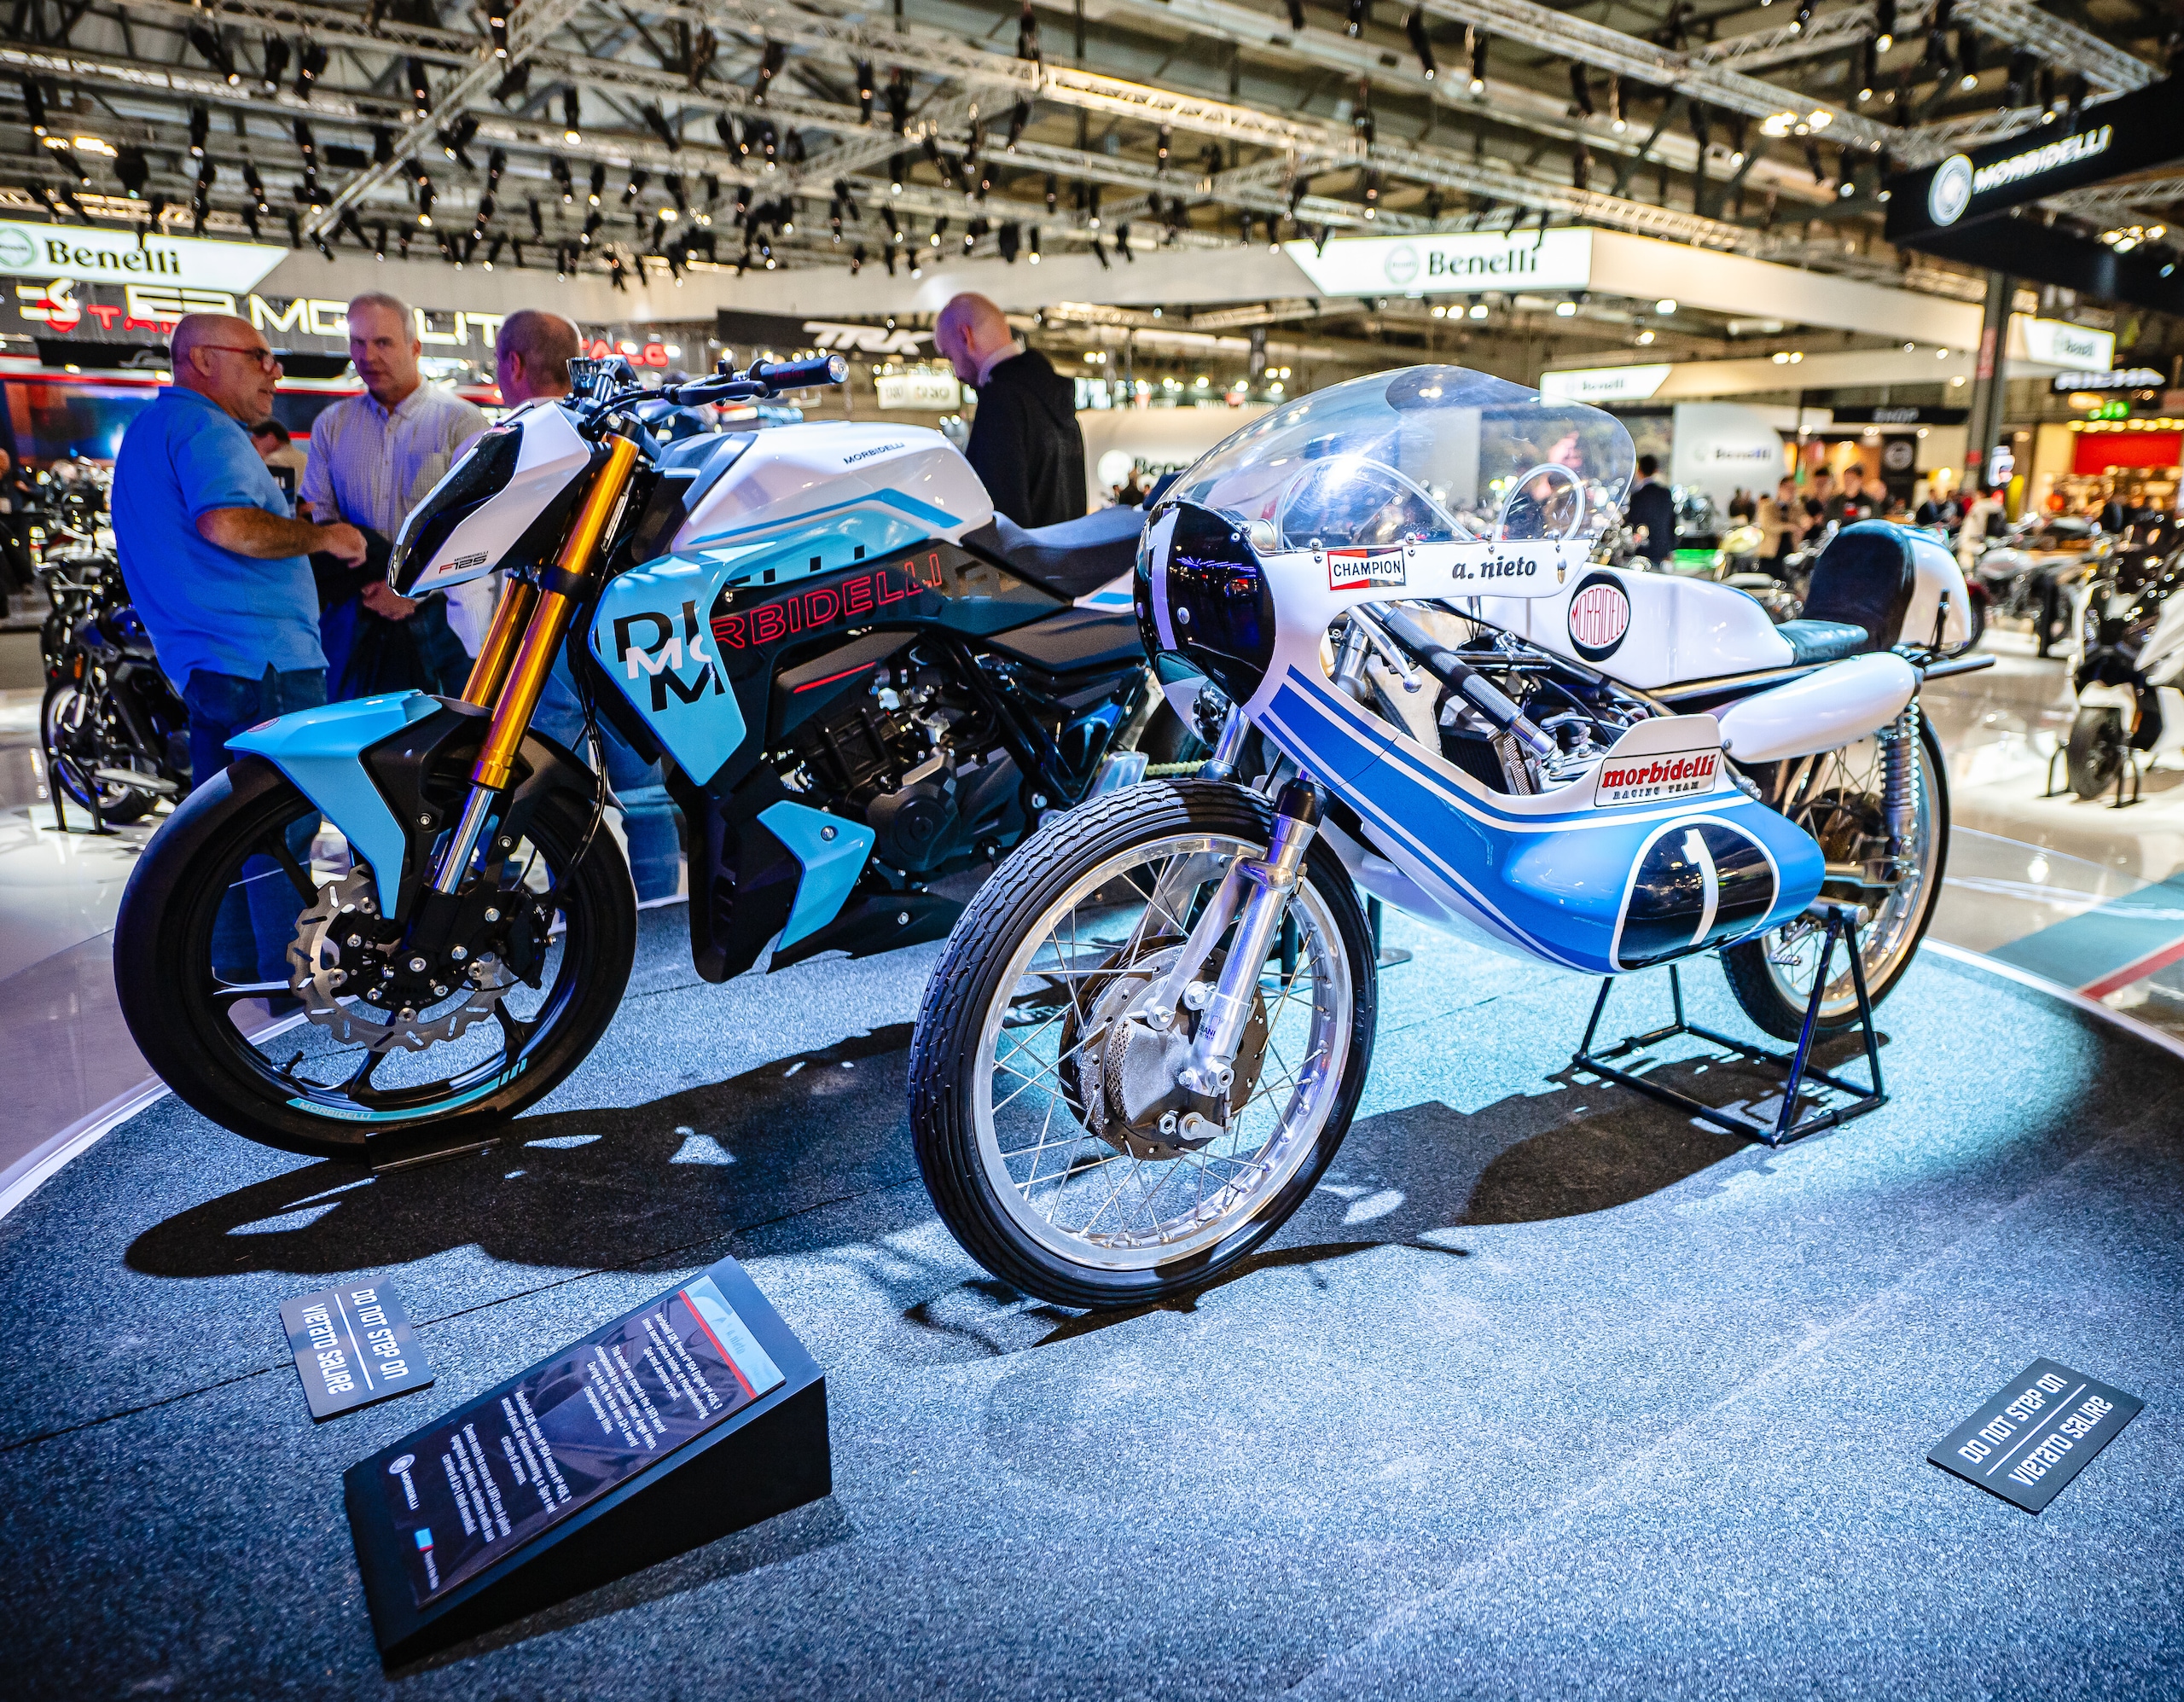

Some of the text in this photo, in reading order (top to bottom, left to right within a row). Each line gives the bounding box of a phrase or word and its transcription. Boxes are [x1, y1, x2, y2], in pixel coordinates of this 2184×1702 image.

[1972, 125, 2113, 195] MORBIDELLI
[44, 239, 182, 276] Benelli
[1428, 248, 1538, 276] Benelli
[843, 442, 906, 465] MORBIDELLI
[439, 555, 488, 574] F125
[1333, 560, 1402, 578] CHAMPION
[1481, 555, 1538, 579] nieto
[1571, 588, 1628, 646] MORBIDELLI
[1602, 754, 1716, 787] morbidelli
[1612, 781, 1700, 800] RACING TEAM
[299, 1101, 372, 1120] MORBIDELLI
[685, 1359, 699, 1373] 504
[537, 1444, 551, 1459] 504
[399, 1468, 419, 1511] MORBIDELLI
